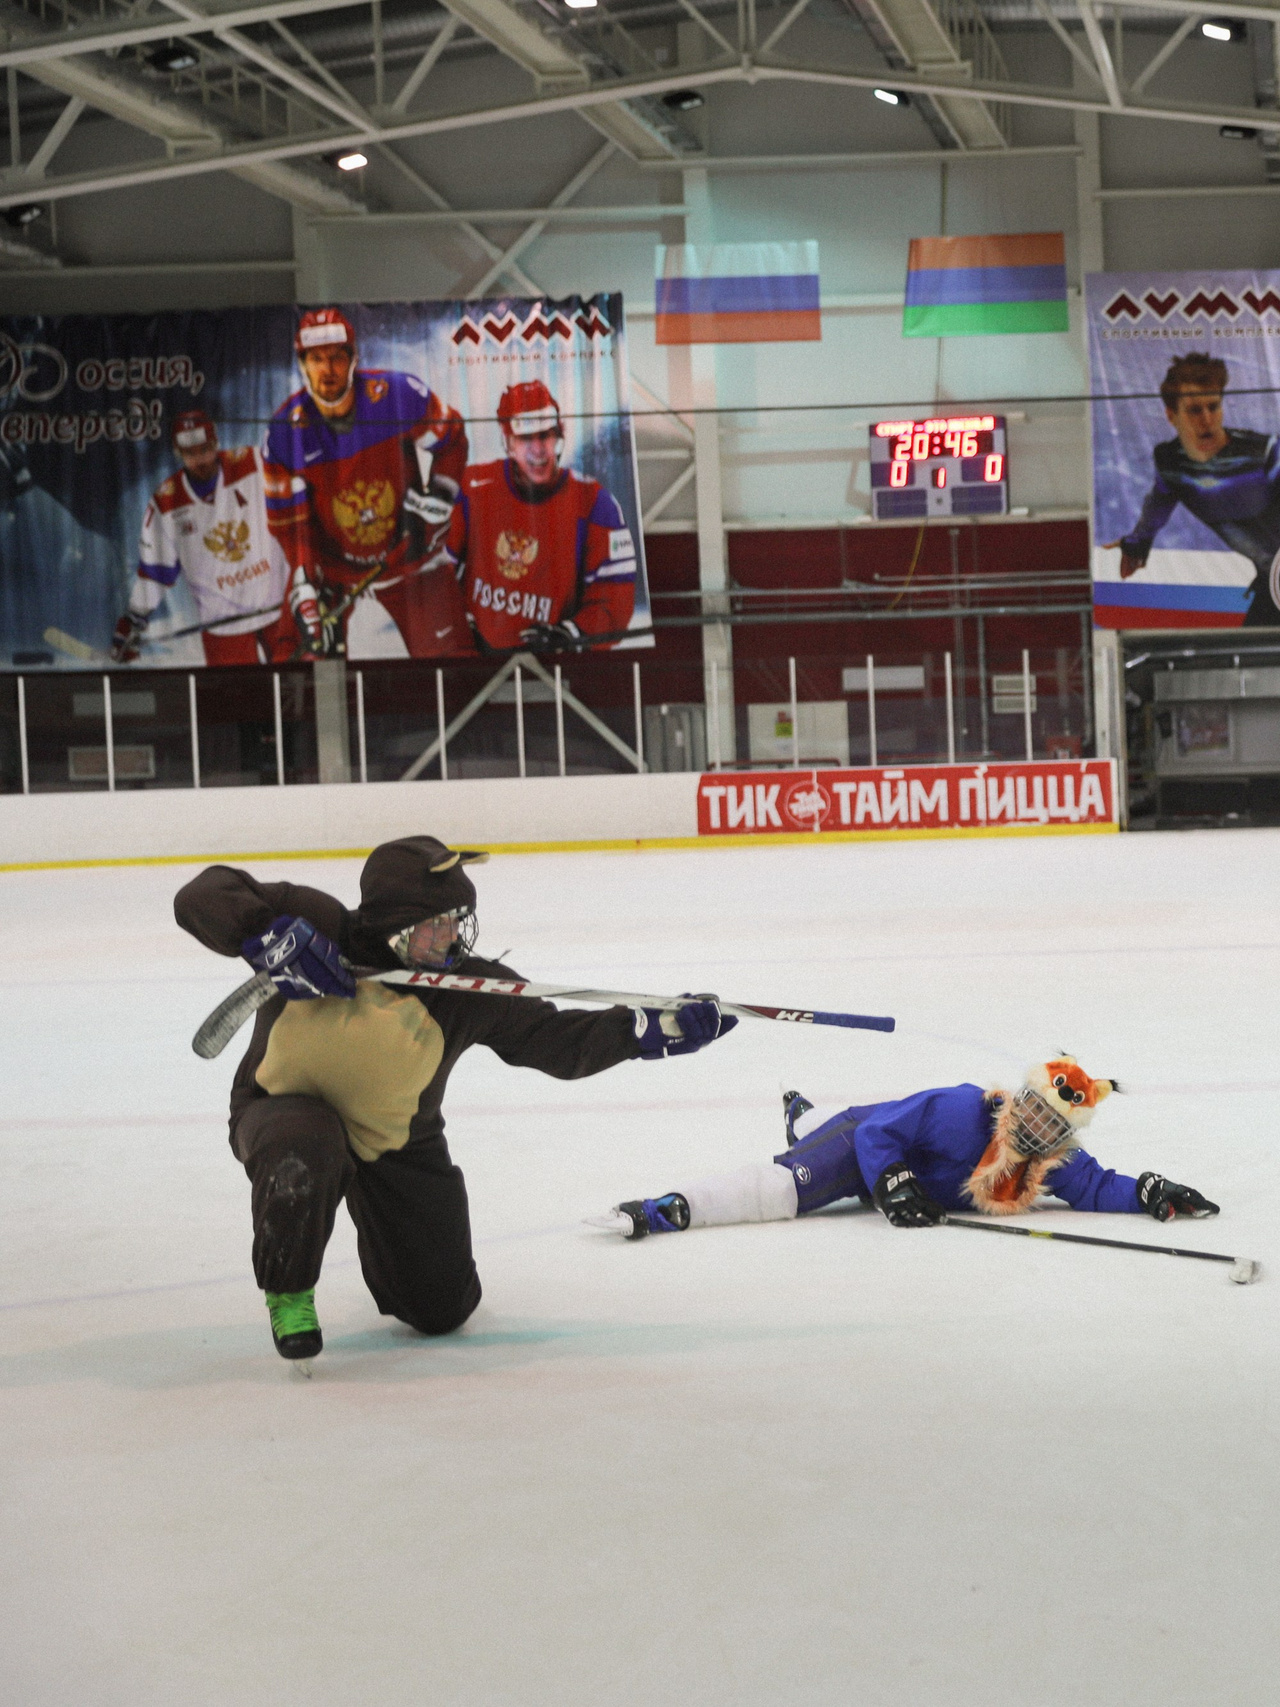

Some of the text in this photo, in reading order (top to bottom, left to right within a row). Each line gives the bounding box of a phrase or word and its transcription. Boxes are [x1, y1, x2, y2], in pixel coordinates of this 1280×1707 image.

[894, 430, 978, 460] 20:46
[890, 453, 1003, 488] 0 1 0
[216, 558, 271, 590] РОССИЯ
[473, 577, 552, 622] РОССИЯ
[701, 784, 783, 829] ТИК
[832, 770, 949, 825] ТАЙМ
[958, 773, 1106, 823] ПИЦЦА
[407, 971, 527, 996] CCM
